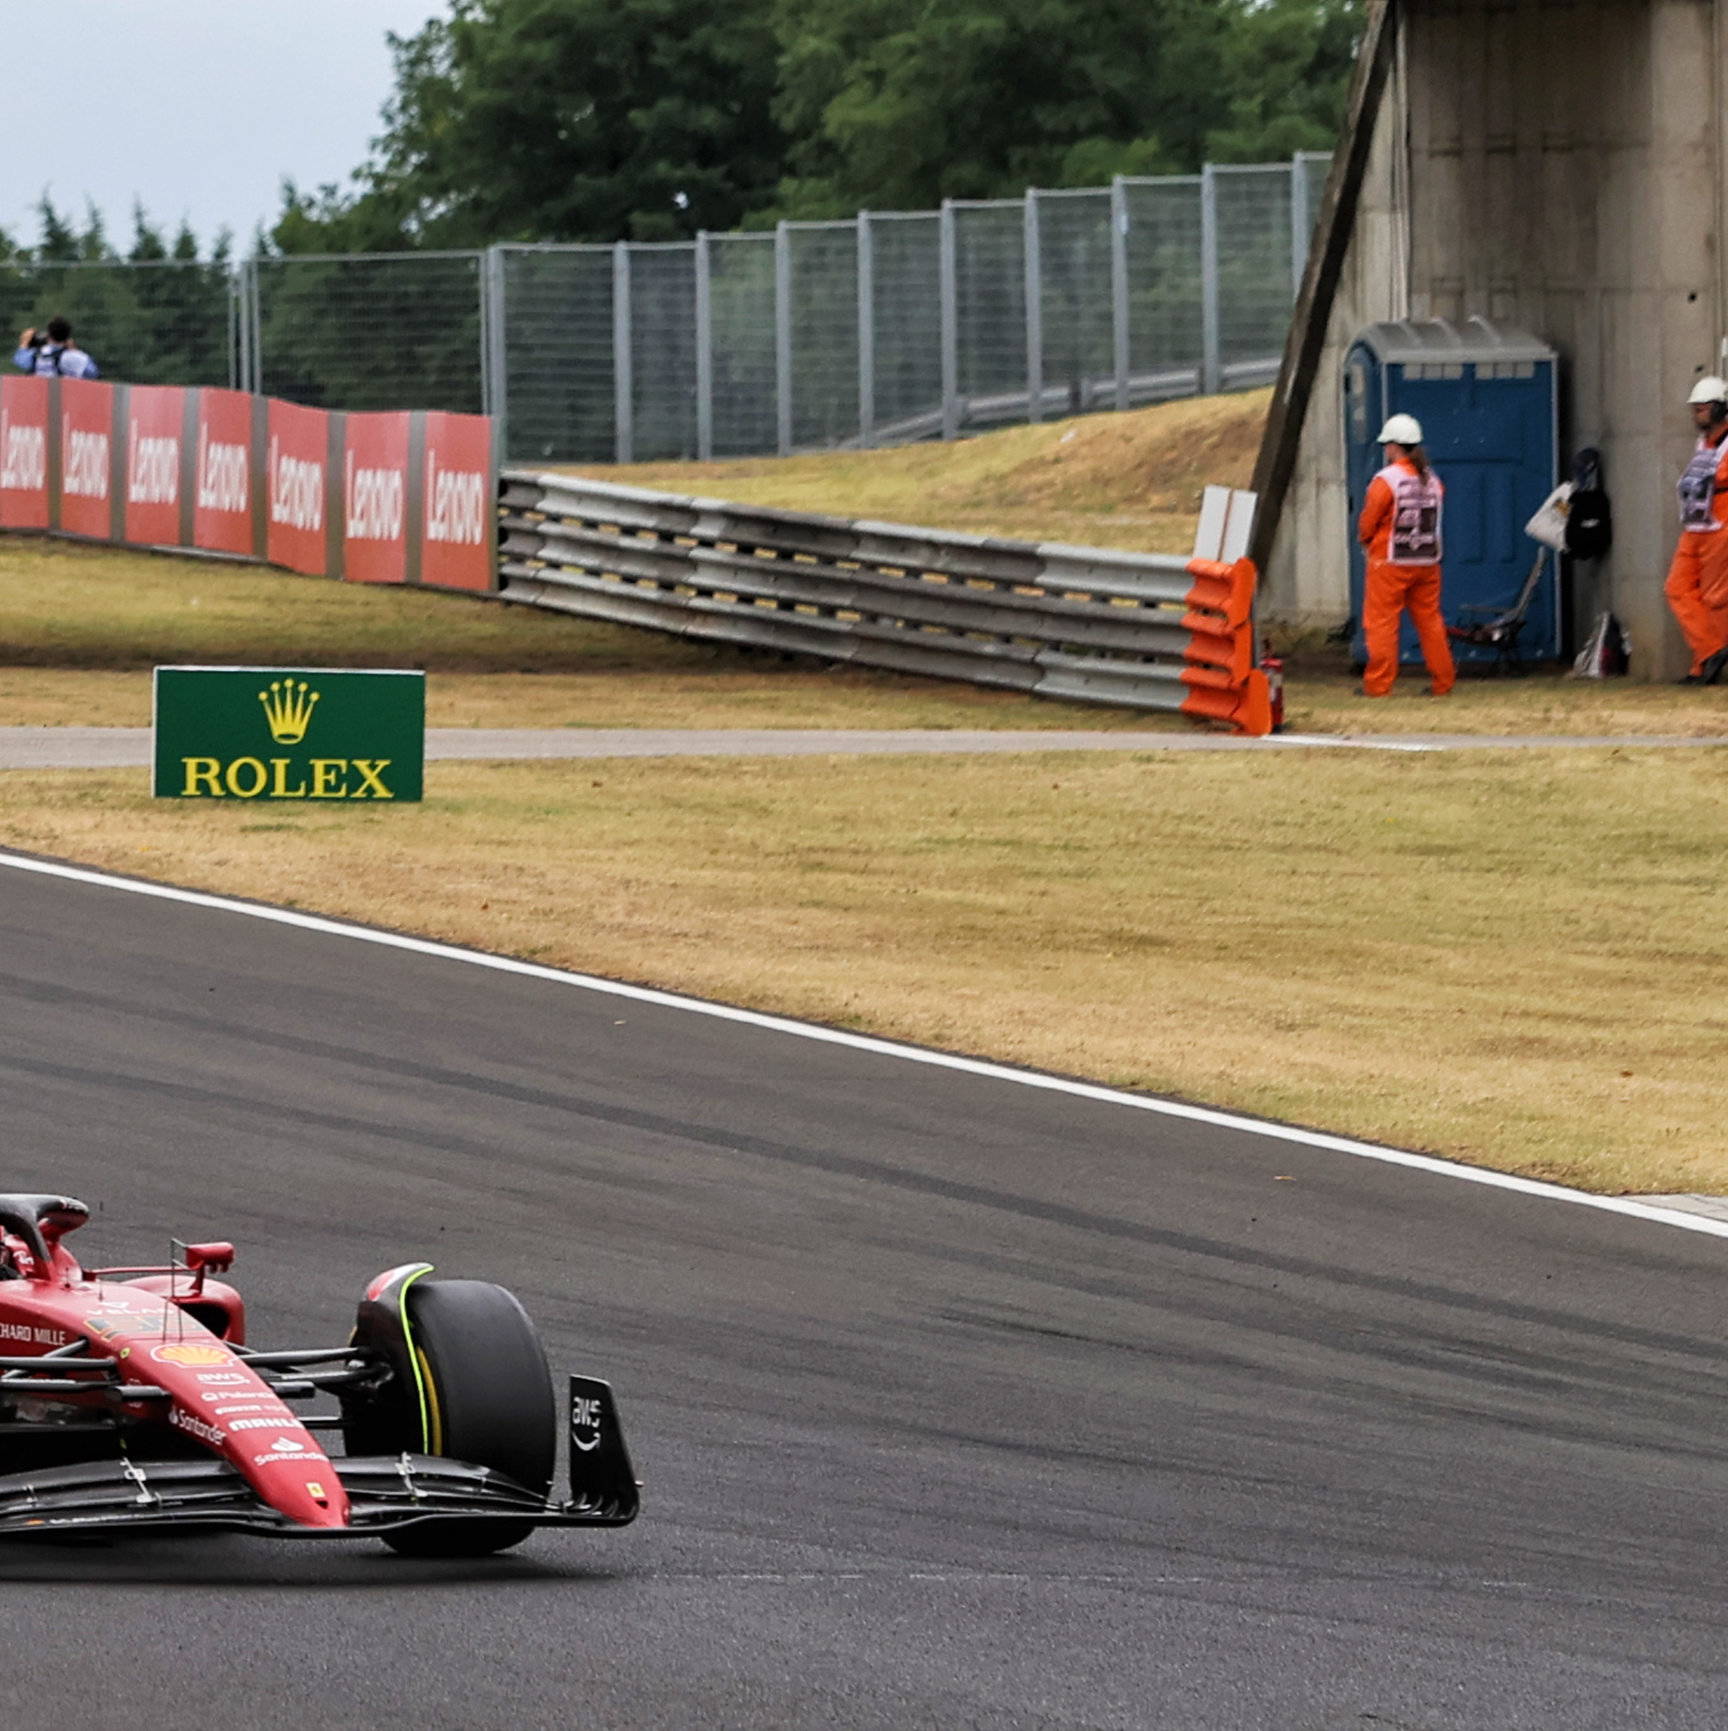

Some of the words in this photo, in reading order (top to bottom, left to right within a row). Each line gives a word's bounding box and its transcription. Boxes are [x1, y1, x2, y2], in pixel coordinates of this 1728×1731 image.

[271, 436, 322, 530] Lenovo
[347, 451, 402, 540] Lenovo
[427, 449, 483, 544] Lenovo
[182, 756, 394, 799] ROLEX
[34, 1326, 66, 1346] MILLE
[178, 1408, 227, 1446] Santander
